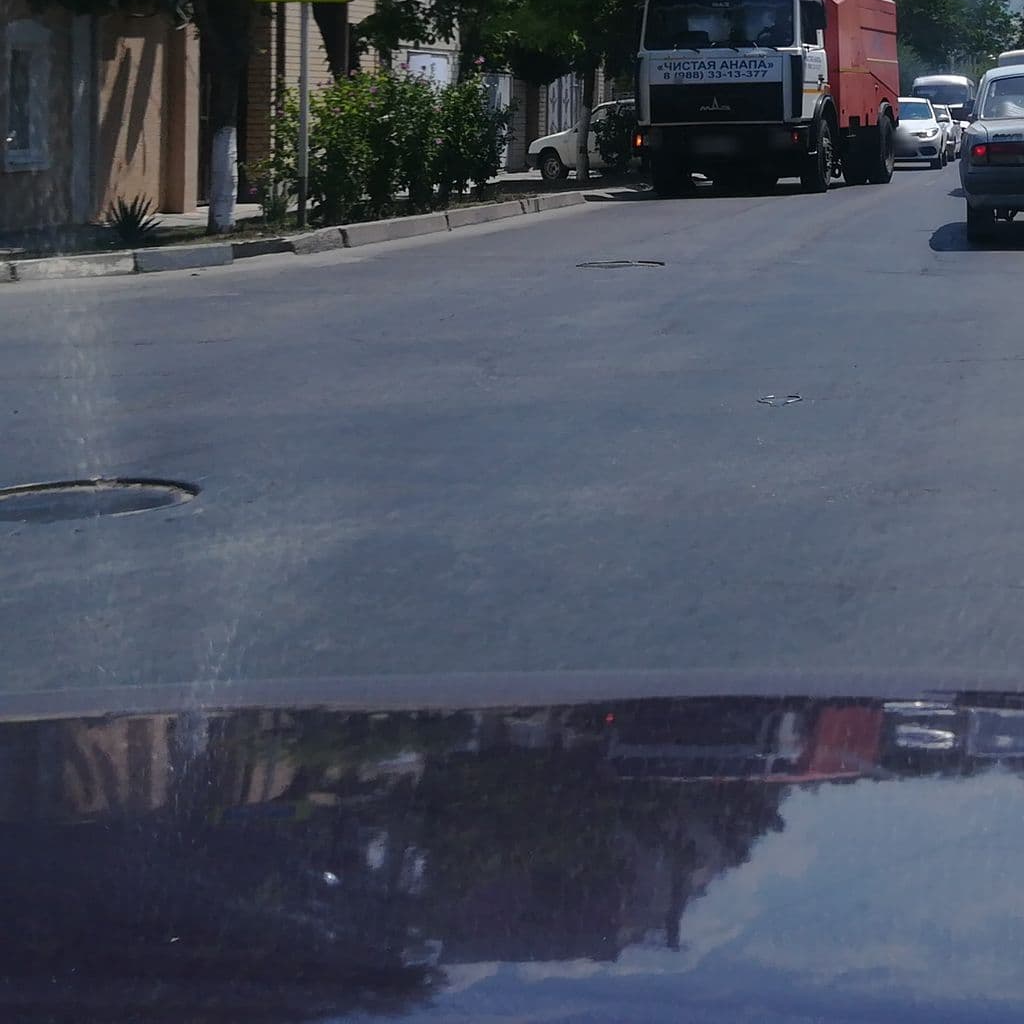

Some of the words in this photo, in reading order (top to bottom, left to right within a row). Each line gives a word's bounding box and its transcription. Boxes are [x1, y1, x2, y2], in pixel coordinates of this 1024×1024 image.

[657, 60, 716, 72] «ЧИСТАЯ
[719, 59, 774, 70] АНАПА»
[663, 72, 670, 80] 8
[674, 71, 705, 80] (988)
[708, 69, 769, 79] 33-13-377
